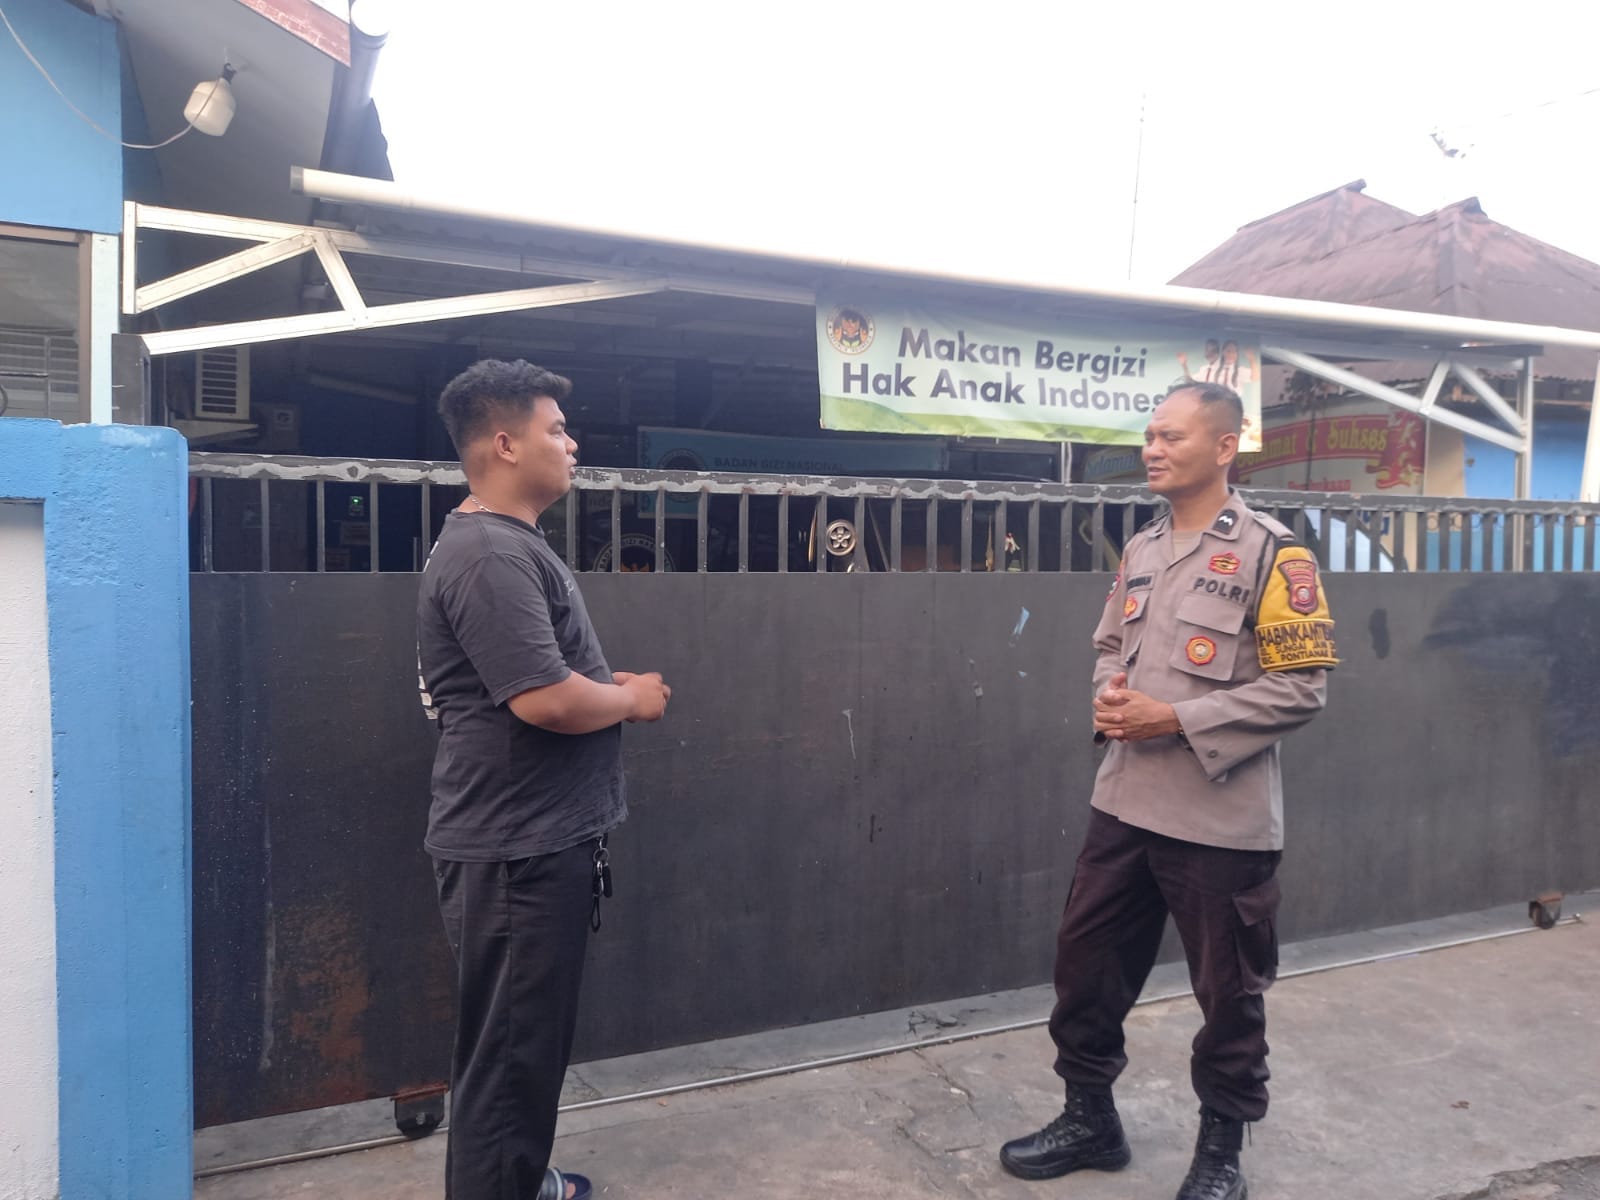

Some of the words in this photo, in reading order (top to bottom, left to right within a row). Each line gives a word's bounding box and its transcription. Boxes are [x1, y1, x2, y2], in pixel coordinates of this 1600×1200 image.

[898, 327, 1021, 368] Makan
[1035, 340, 1148, 384] Bergizi
[842, 362, 917, 398] Hak
[930, 368, 1026, 405] Anak
[1038, 376, 1167, 414] Indones
[1327, 419, 1388, 451] Sukses
[714, 457, 758, 468] BADAN
[1194, 579, 1249, 603] POLRI
